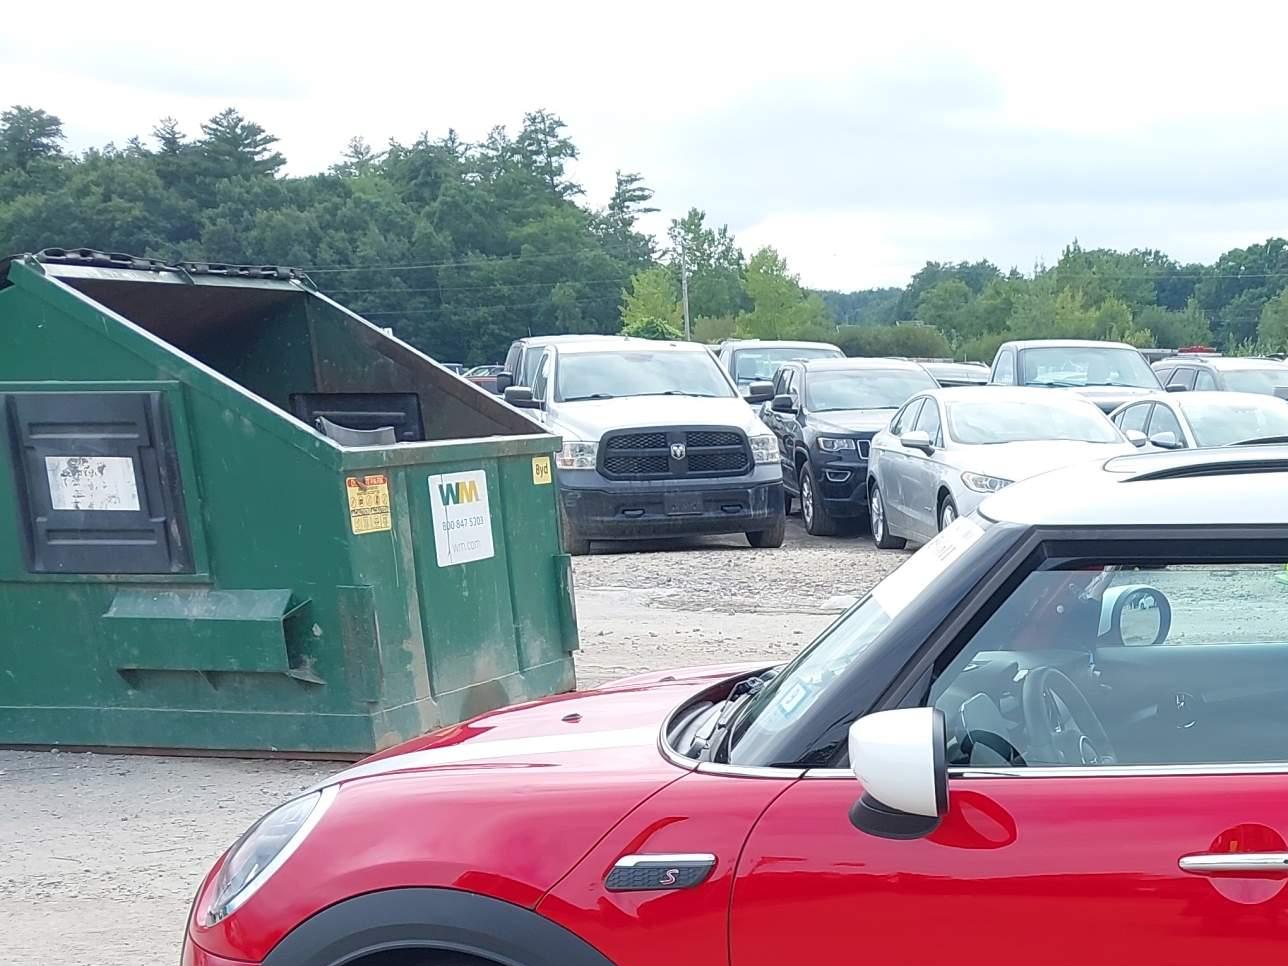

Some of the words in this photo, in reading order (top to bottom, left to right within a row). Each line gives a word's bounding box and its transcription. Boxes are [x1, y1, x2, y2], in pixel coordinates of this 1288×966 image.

[438, 480, 480, 506] WM
[456, 518, 468, 529] 847
[659, 868, 680, 886] S
